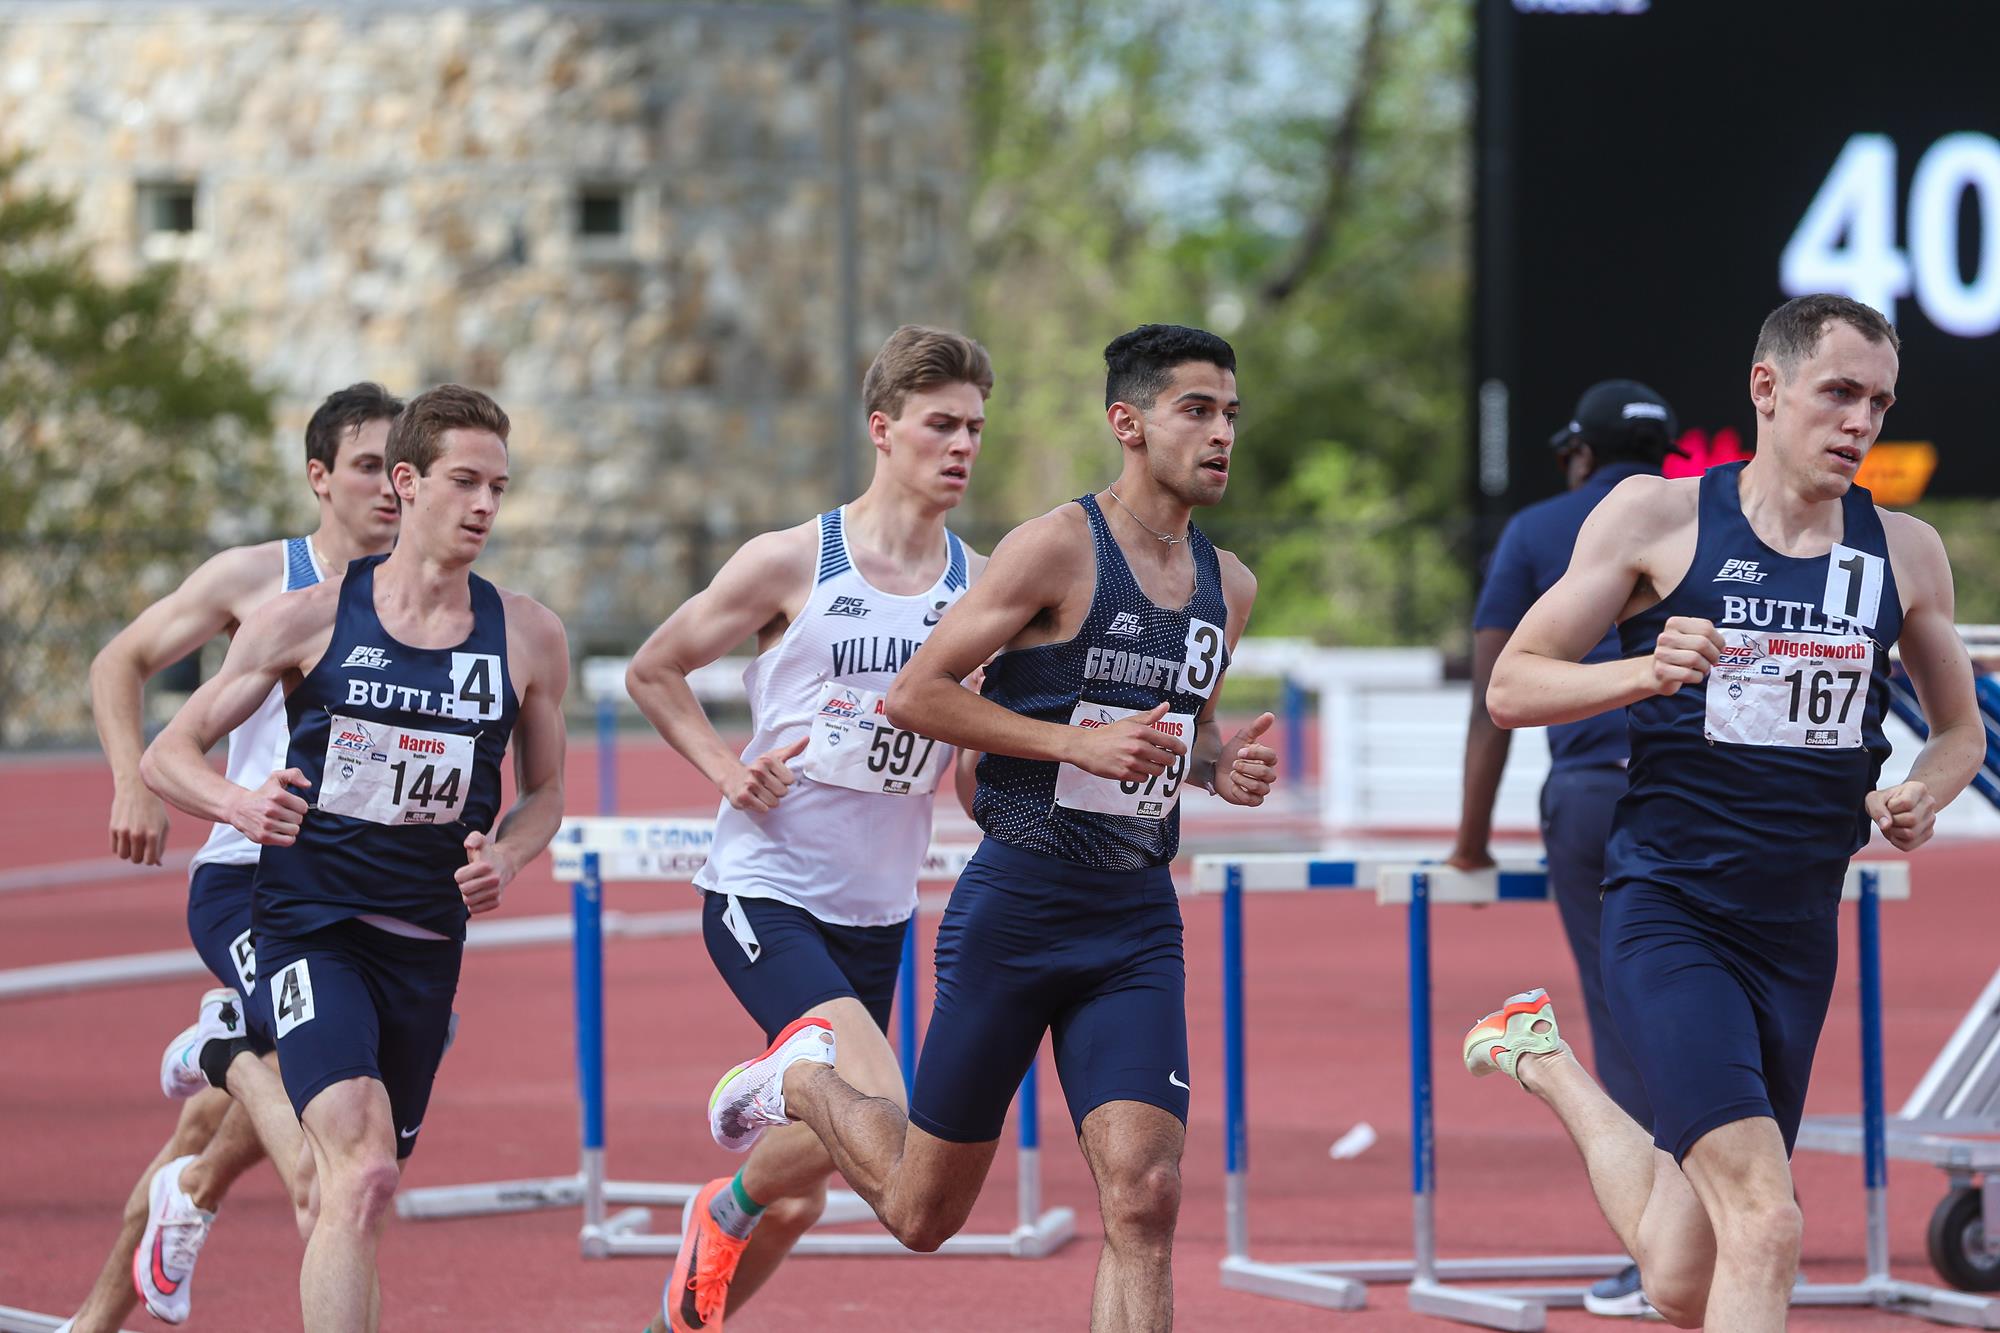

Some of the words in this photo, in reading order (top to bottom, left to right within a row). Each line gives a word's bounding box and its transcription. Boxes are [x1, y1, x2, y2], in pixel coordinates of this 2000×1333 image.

[1780, 131, 2000, 338] 40
[1723, 558, 1760, 571] BIG
[1716, 569, 1768, 582] EAST
[1838, 555, 1865, 619] 1
[834, 596, 865, 607] BIG
[828, 605, 871, 617] EAST
[1115, 611, 1140, 623] BIG
[1109, 622, 1145, 634] EAST
[352, 645, 385, 657] BIG
[1768, 639, 1865, 660] Wigelsworth
[345, 654, 392, 668] EAST
[1187, 626, 1218, 690] 3
[1719, 655, 1760, 665] EAST
[1084, 647, 1191, 695] GEORGET
[459, 658, 496, 715] 4
[345, 679, 479, 723] BUTLE
[1784, 669, 1862, 725] 167
[822, 706, 857, 718] EAST
[828, 700, 855, 710] BIG
[340, 731, 365, 742] BIG
[335, 738, 368, 751] EAST
[399, 734, 445, 754] Harris
[867, 726, 935, 777] 597
[390, 760, 461, 809] 144
[278, 967, 307, 1022] 4
